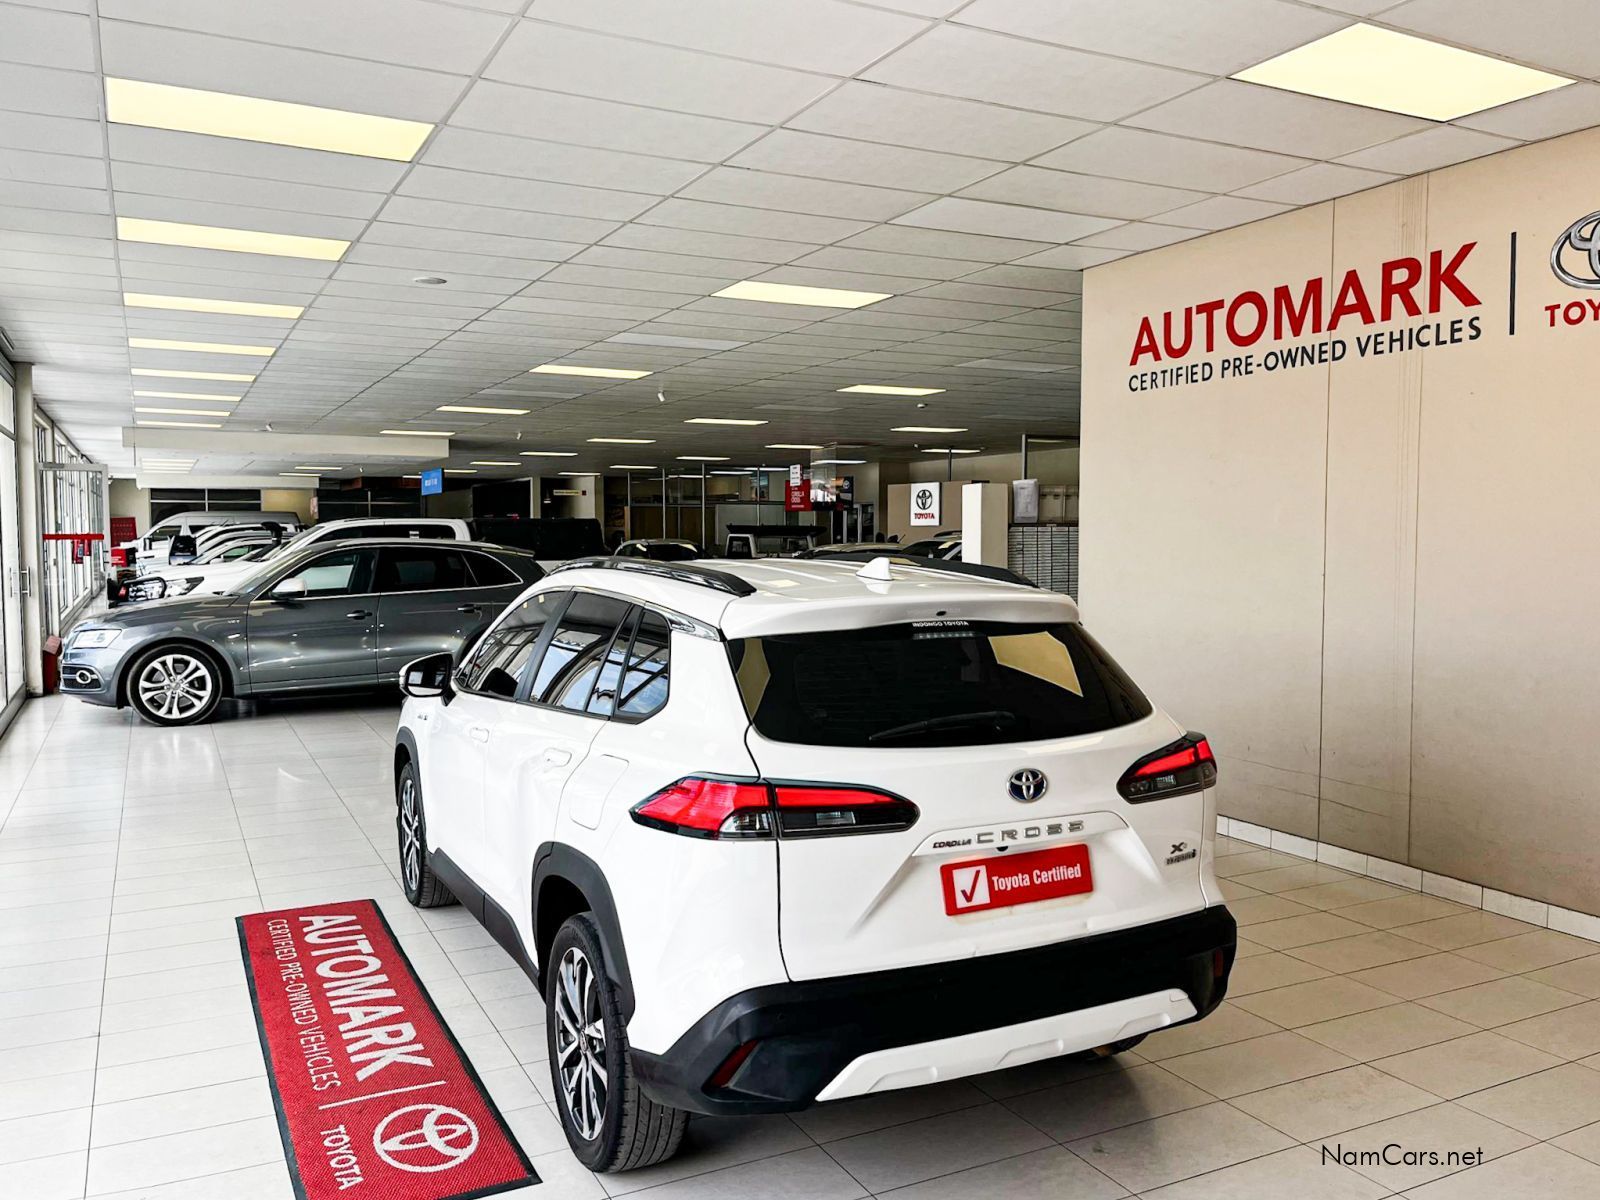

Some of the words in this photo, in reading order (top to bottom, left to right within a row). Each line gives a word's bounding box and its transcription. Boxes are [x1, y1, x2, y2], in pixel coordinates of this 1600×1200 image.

[1129, 241, 1483, 367] AUTOMARK
[1128, 362, 1213, 392] CERTIFIED
[1220, 340, 1347, 379] PRE-OWNED
[1356, 316, 1482, 360] VEHICLES
[933, 838, 972, 849] COROLLA
[976, 821, 1084, 844] CROSS
[992, 871, 1031, 892] Toyota
[1033, 864, 1082, 883] Certified
[266, 919, 298, 962] CERTIFIED
[279, 963, 319, 1026] PRE-OWNED
[298, 915, 434, 1082] AUTOMARK
[298, 1026, 342, 1092] VEHICLES
[319, 1124, 364, 1191] TOYOTA
